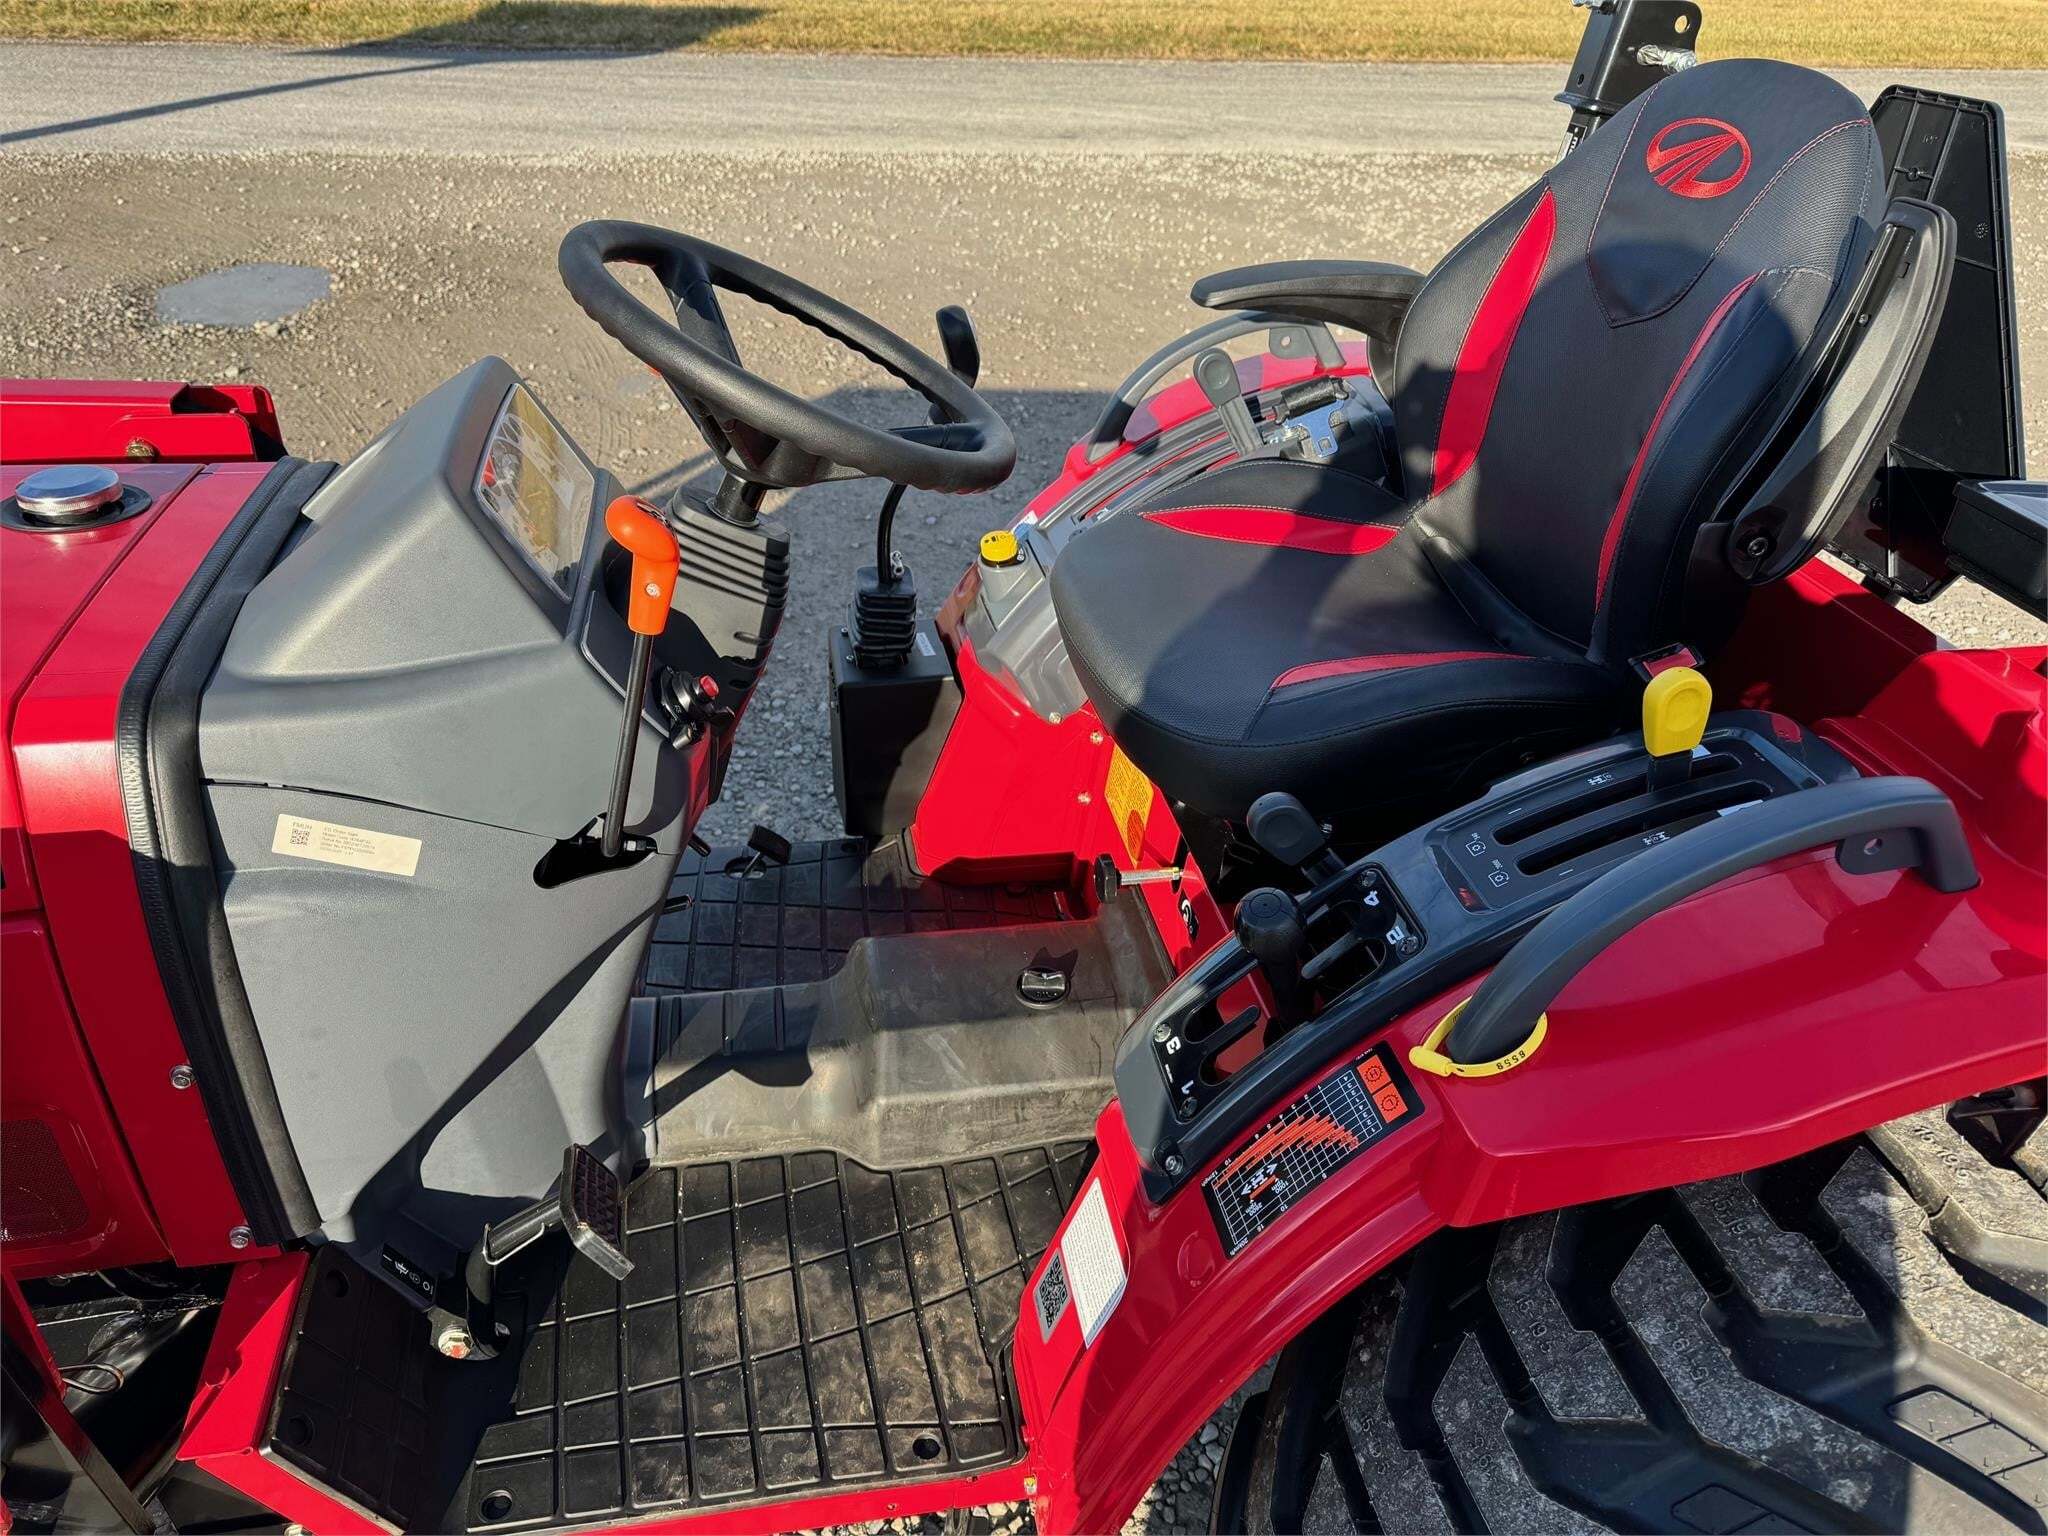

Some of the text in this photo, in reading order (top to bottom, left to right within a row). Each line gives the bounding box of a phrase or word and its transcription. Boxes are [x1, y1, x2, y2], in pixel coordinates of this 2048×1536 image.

[1363, 890, 1379, 907] 4
[1385, 926, 1403, 945] 2
[1166, 1037, 1181, 1054] 3
[1180, 1079, 1195, 1094] 1
[1275, 1181, 1289, 1195] 1000
[1280, 1204, 1289, 1212] 10
[1257, 1225, 1266, 1233] 15
